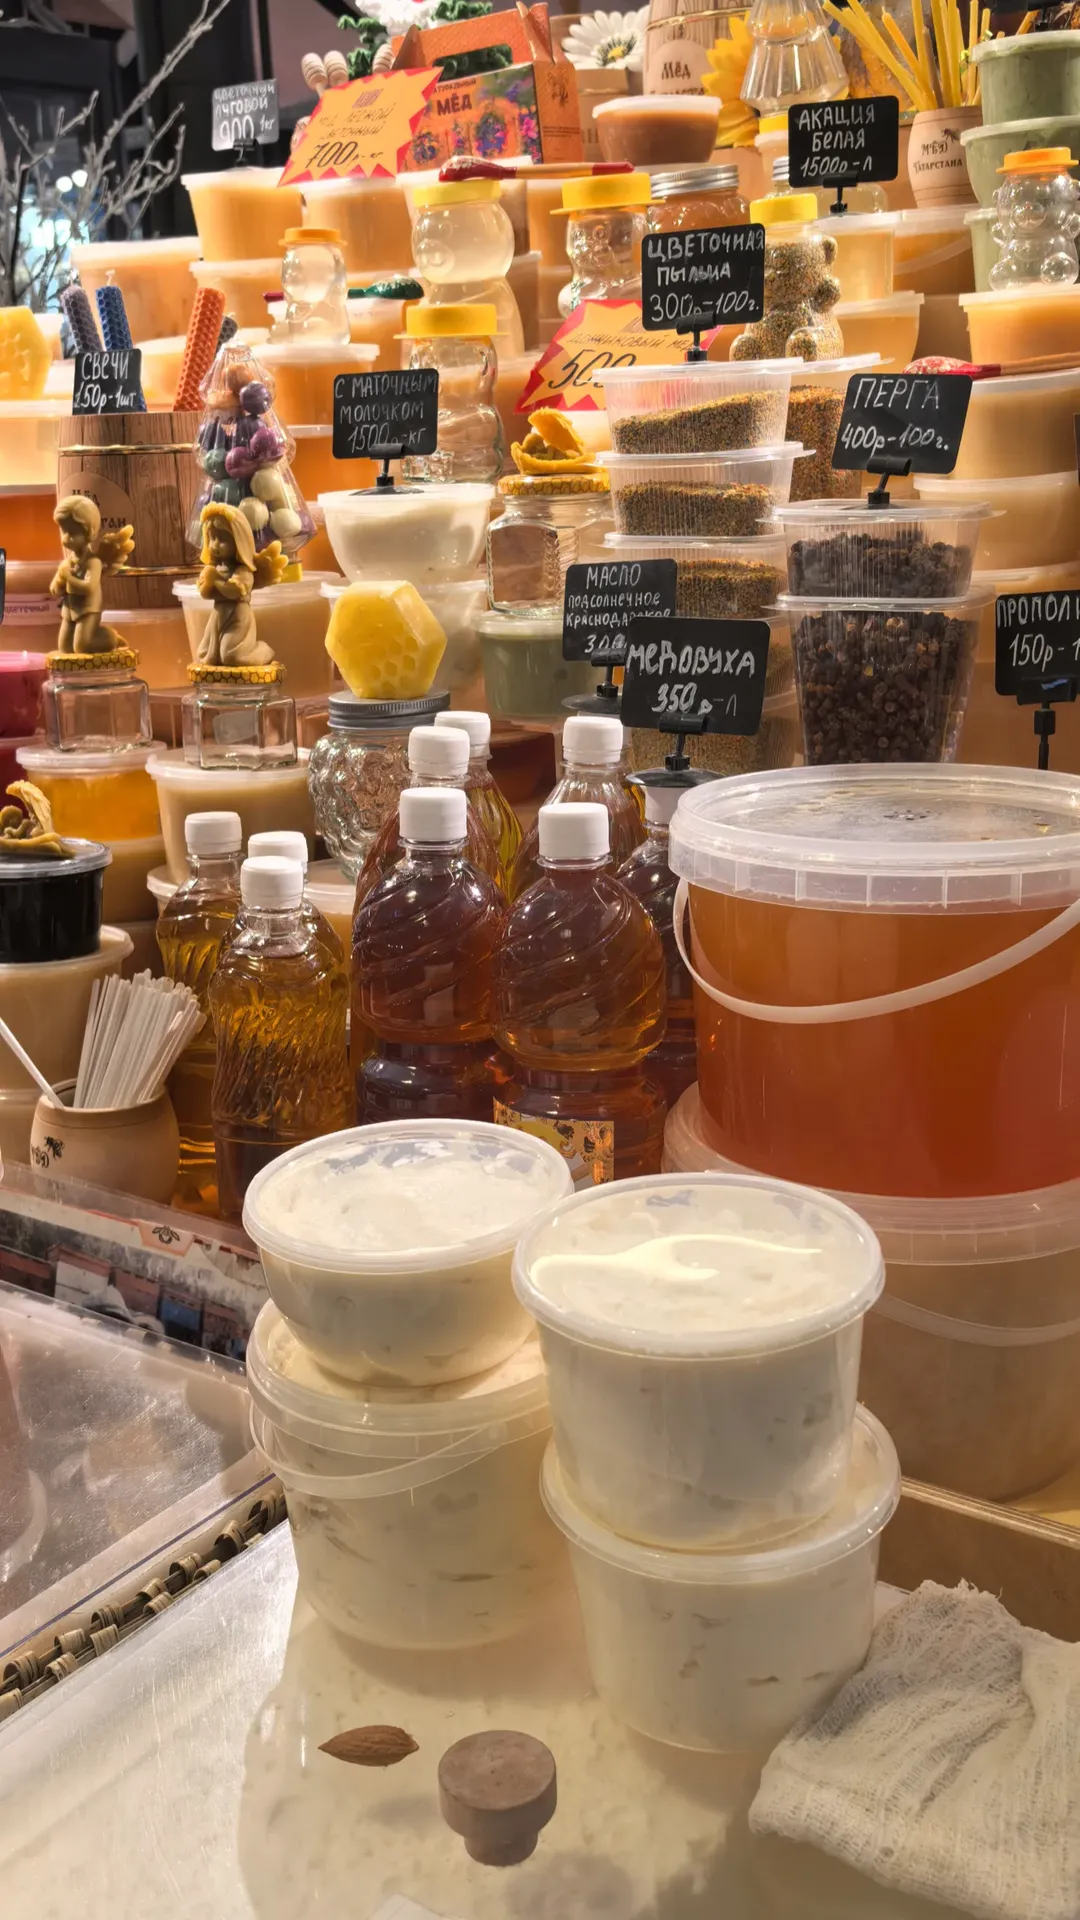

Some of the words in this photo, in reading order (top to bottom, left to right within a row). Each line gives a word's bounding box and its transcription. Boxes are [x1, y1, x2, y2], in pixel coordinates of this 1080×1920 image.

[433, 77, 476, 93] АТУРАЛЬНЫЙ
[436, 94, 472, 116] МЁД
[798, 103, 875, 131] АКАЦИЯ
[647, 229, 765, 263] ЦВЕТОЧНАЯ
[334, 378, 346, 399] С
[351, 373, 437, 399] МАТОЧНЫМ
[852, 377, 940, 410] ПЕРГА
[339, 401, 424, 425] МОЛОЧКОМ
[586, 563, 642, 590] МАСЛО
[626, 640, 756, 678] МЕДОВУХА
